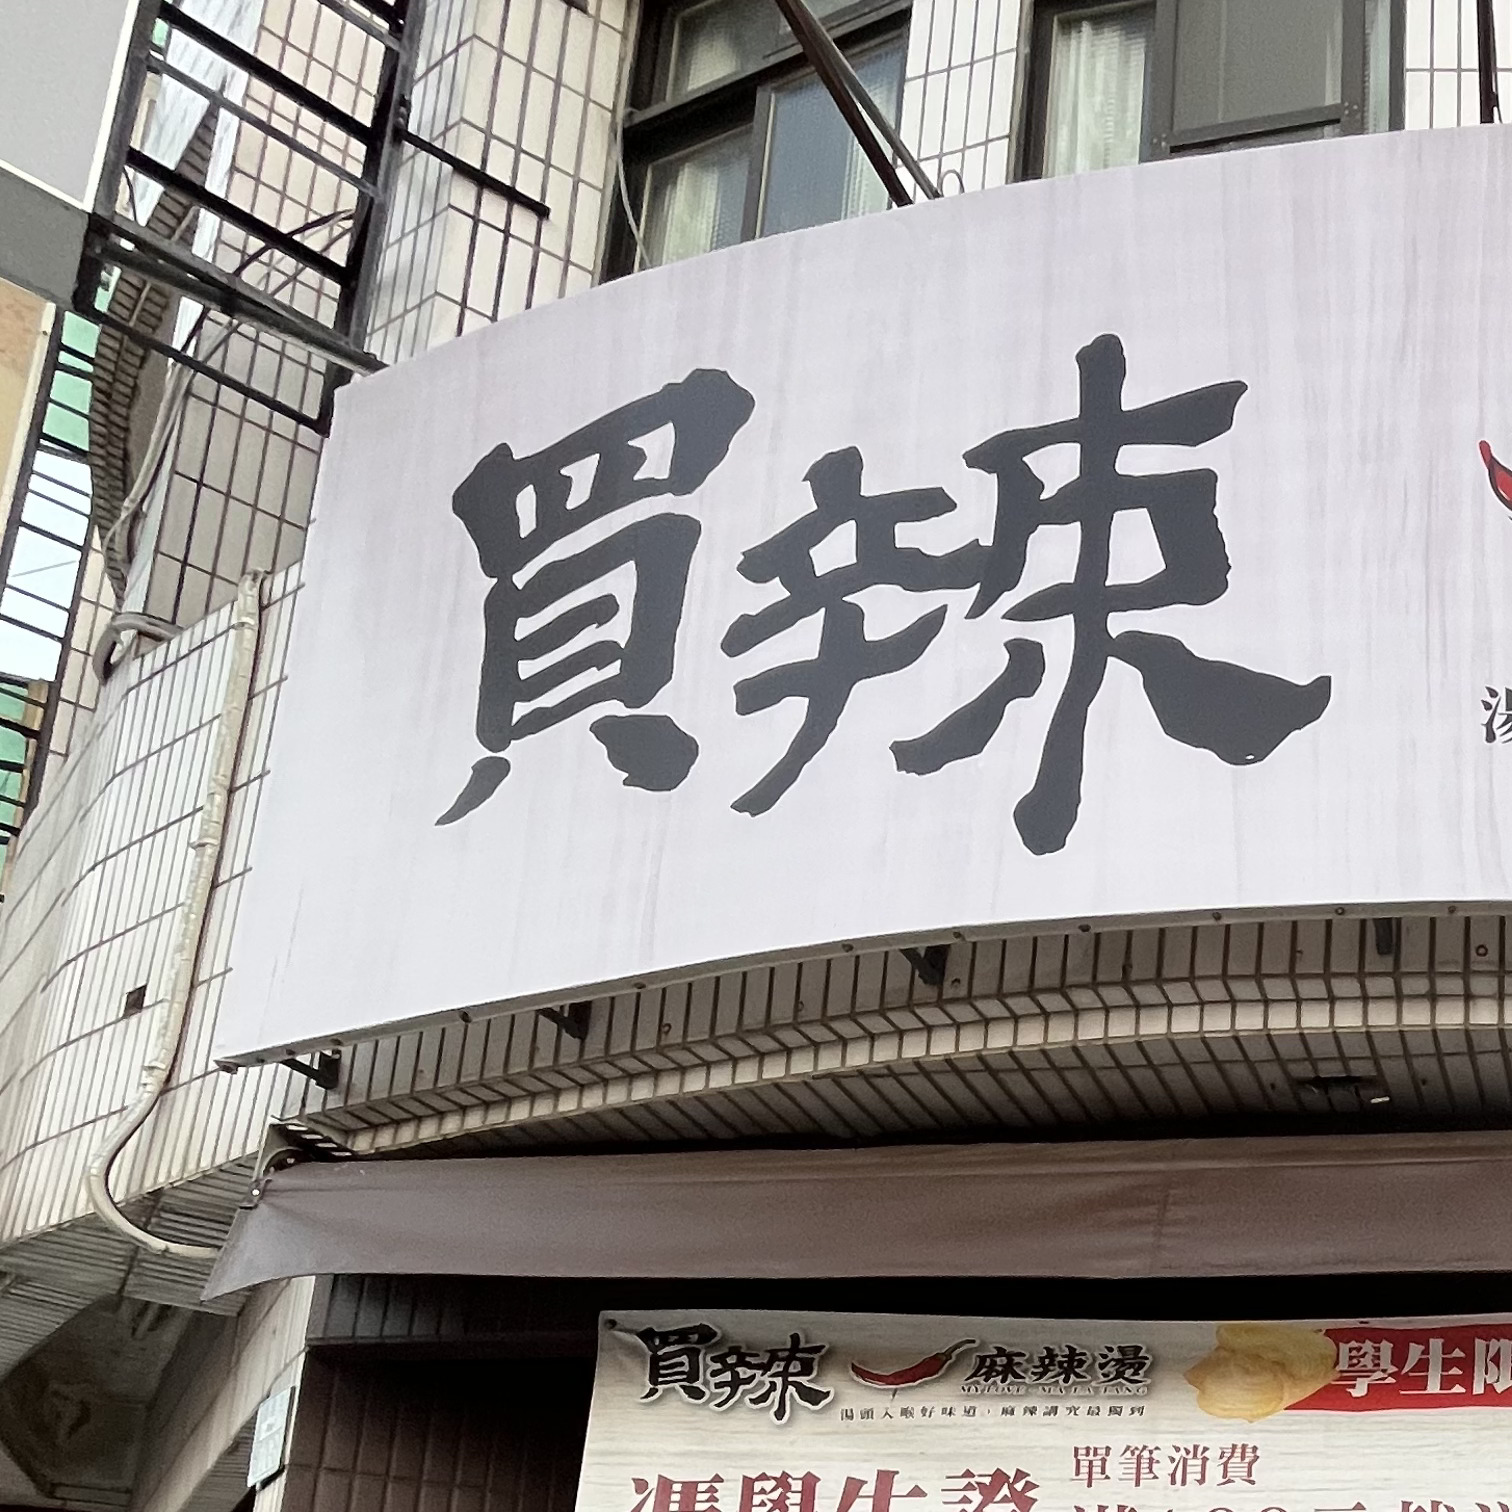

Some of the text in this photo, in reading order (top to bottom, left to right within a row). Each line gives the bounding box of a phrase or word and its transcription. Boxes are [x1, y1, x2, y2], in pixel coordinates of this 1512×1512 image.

[435, 334, 1331, 855] 買辣
[637, 1324, 833, 1421] 買辣
[965, 1345, 1151, 1385] 麻辣燙
[1071, 1444, 1261, 1488] 單筆消費
